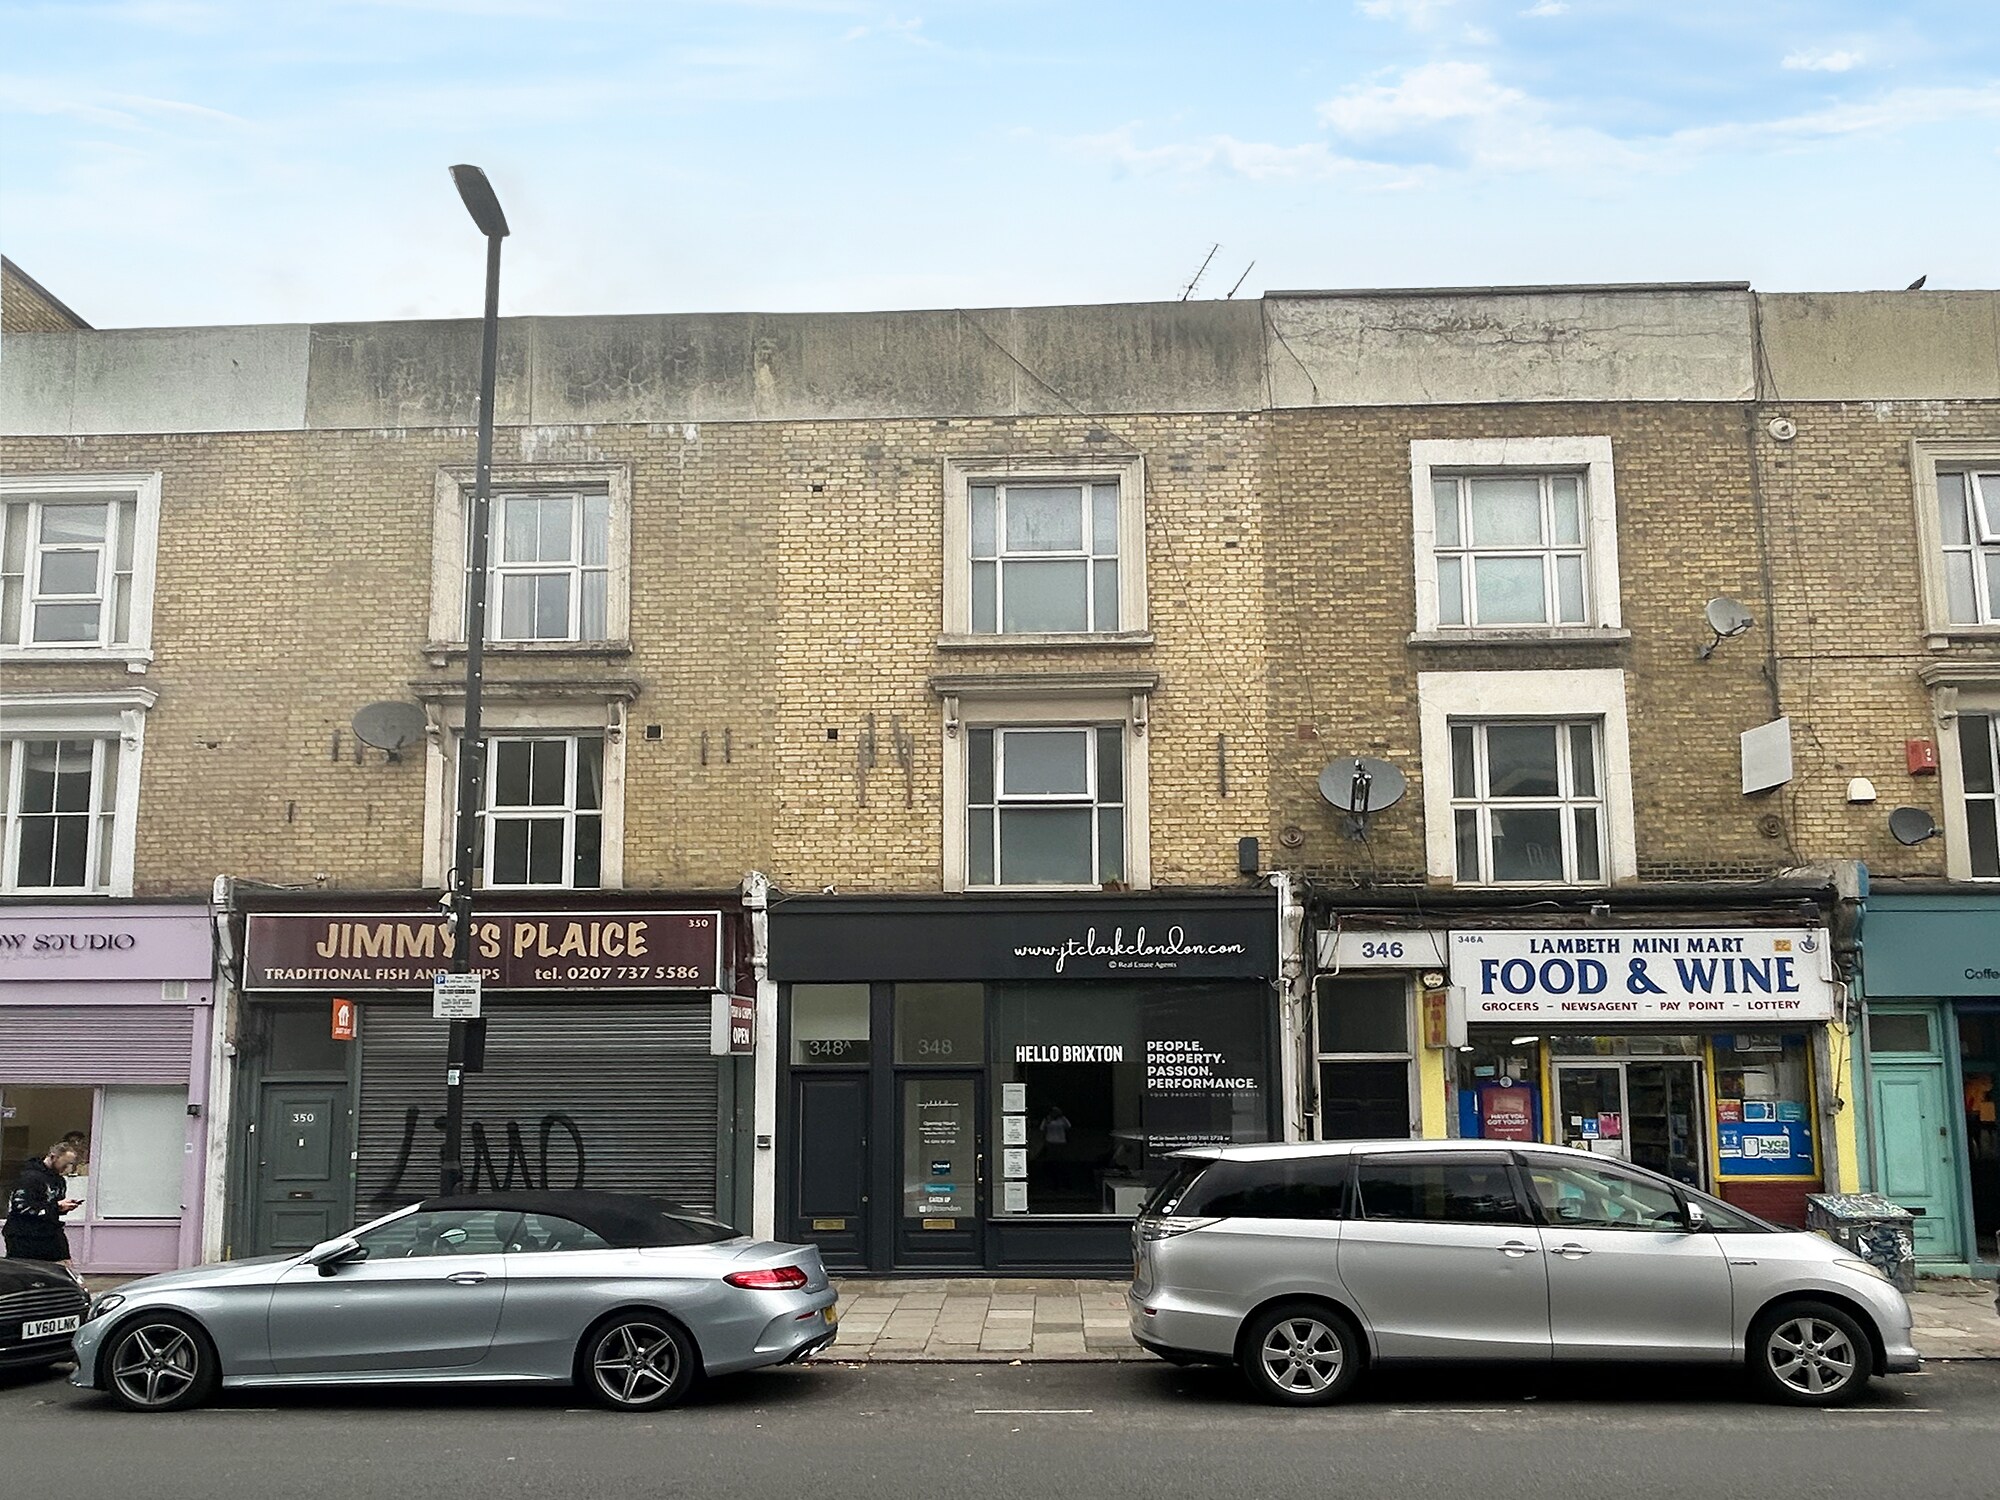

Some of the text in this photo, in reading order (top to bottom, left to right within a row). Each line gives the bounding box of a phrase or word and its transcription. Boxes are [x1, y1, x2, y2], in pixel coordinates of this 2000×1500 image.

[688, 918, 709, 928] 350
[0, 933, 135, 951] W STUDIO
[316, 920, 649, 959] JIMMY'S PLAICE
[1458, 935, 1484, 944] 346A
[1530, 937, 1744, 954] LAMBETH MINI MART
[1362, 941, 1404, 959] 346
[1155, 961, 1177, 969] Agents
[264, 967, 371, 980] TRADITIONAL
[376, 967, 410, 980] FISH
[535, 966, 700, 980] tel. 0207 737 5586
[1480, 956, 1800, 995] FOOD & WINE
[1965, 968, 2000, 980] Coffe
[1482, 1001, 1539, 1011] GROCERS
[1561, 1001, 1638, 1011] NEWSAGENT
[1660, 1001, 1681, 1011] PAY
[1689, 1001, 1725, 1011] POINT
[1748, 1000, 1801, 1010] LOTTERY
[732, 1026, 749, 1044] OPEN
[918, 1039, 953, 1055] 348
[1147, 1041, 1204, 1052] PEOPLE.
[1016, 1045, 1123, 1063] HELLO BRIXTON
[1147, 1053, 1226, 1064] PROPERTY.
[1147, 1066, 1213, 1076] PASSION.
[1147, 1078, 1258, 1089] PERFORMANCE.
[292, 1113, 314, 1123] 350
[1760, 1138, 1789, 1150] Lyca
[1760, 1147, 1789, 1155] mobile
[27, 1317, 76, 1336] LY60 LNK
